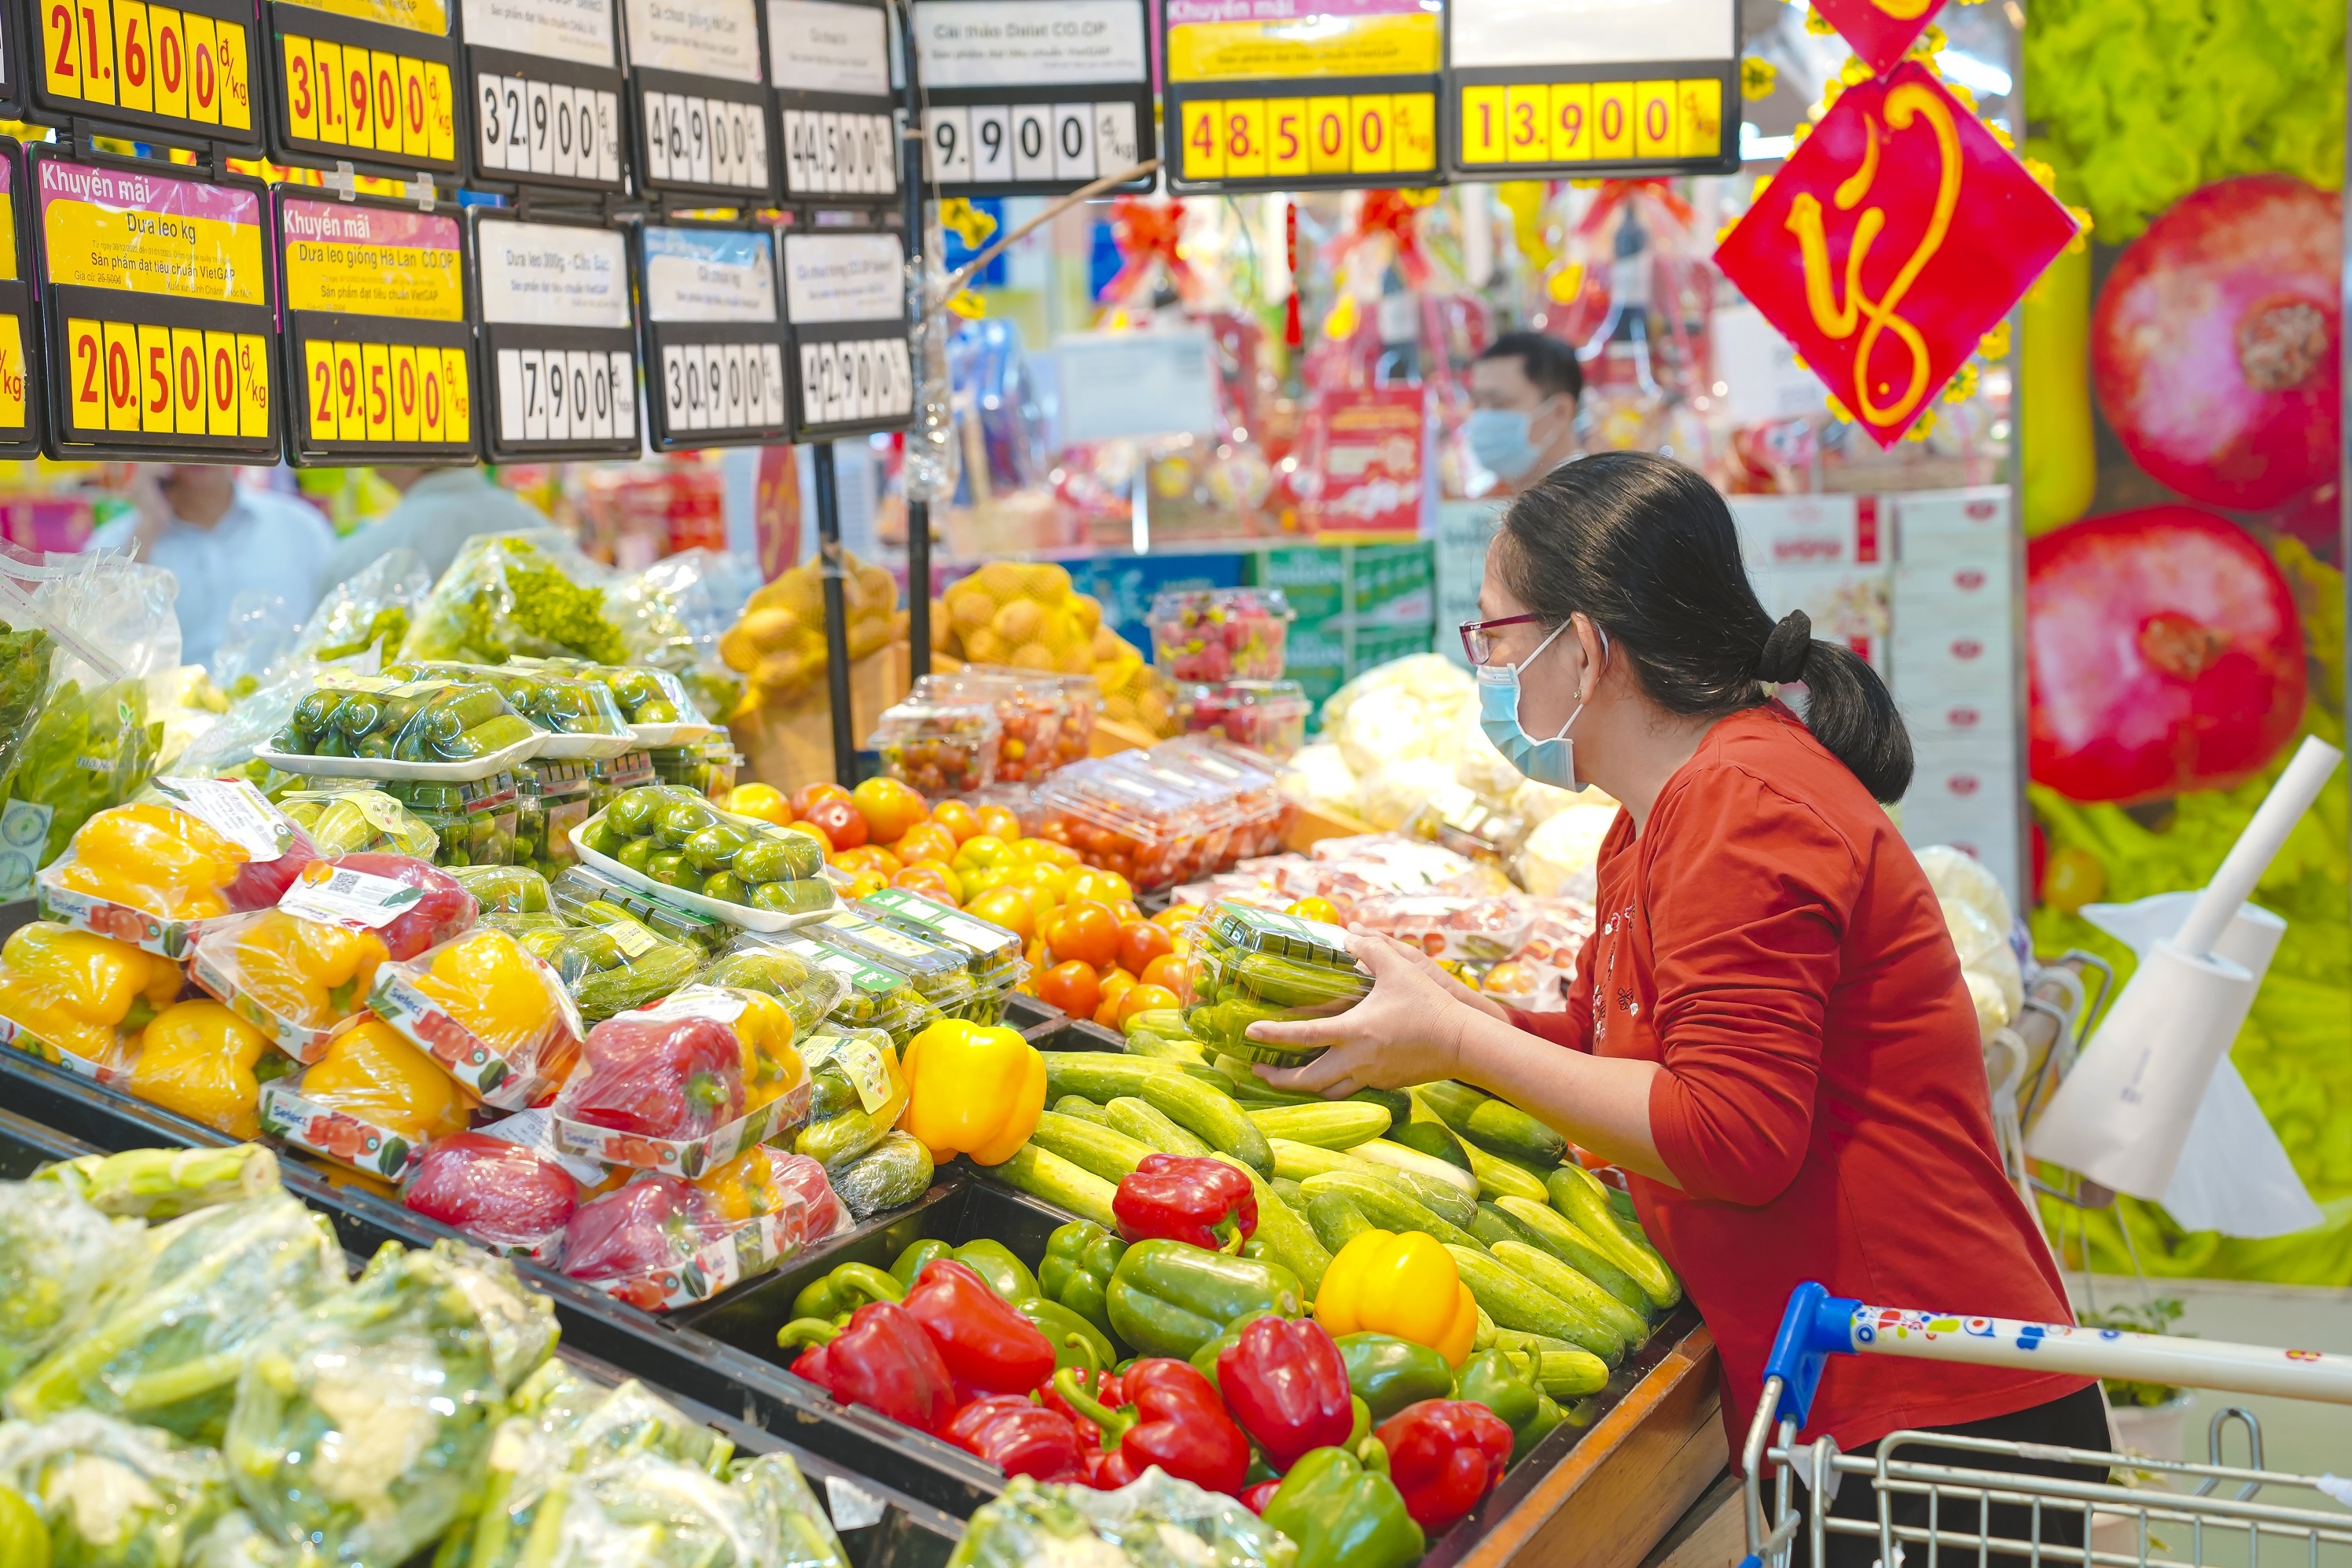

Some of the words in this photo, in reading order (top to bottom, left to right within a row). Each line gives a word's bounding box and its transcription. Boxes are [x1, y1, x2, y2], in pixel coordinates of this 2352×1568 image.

[51, 4, 214, 108] 21.600
[292, 56, 424, 134] 31.900
[484, 86, 592, 158] 32.900
[1477, 96, 1670, 149] 13.900
[652, 105, 745, 165] 46.900
[1191, 111, 1384, 163] 48.500
[42, 163, 113, 200] Khuyến
[119, 175, 151, 204] mãi
[127, 212, 155, 236] Dưa
[158, 216, 178, 238] leo
[182, 221, 196, 244] kg
[284, 207, 340, 241] Khuyến
[344, 213, 370, 239] mãi
[91, 252, 109, 267] Sản
[112, 253, 137, 271] phẩm
[138, 259, 153, 276] đạt
[154, 260, 170, 274] tiêu
[171, 261, 198, 277] chuẩn
[200, 266, 235, 281] VietGAP
[300, 244, 323, 262] Dưa
[326, 245, 344, 263] leo
[347, 244, 377, 269] giống
[397, 250, 417, 267] Lan
[78, 334, 233, 413] 20.500
[242, 344, 266, 408] đ/kg
[316, 358, 440, 428] 29.500
[525, 362, 607, 420] 7.900
[670, 358, 760, 410] 30.900
[807, 354, 891, 411] 42.900
